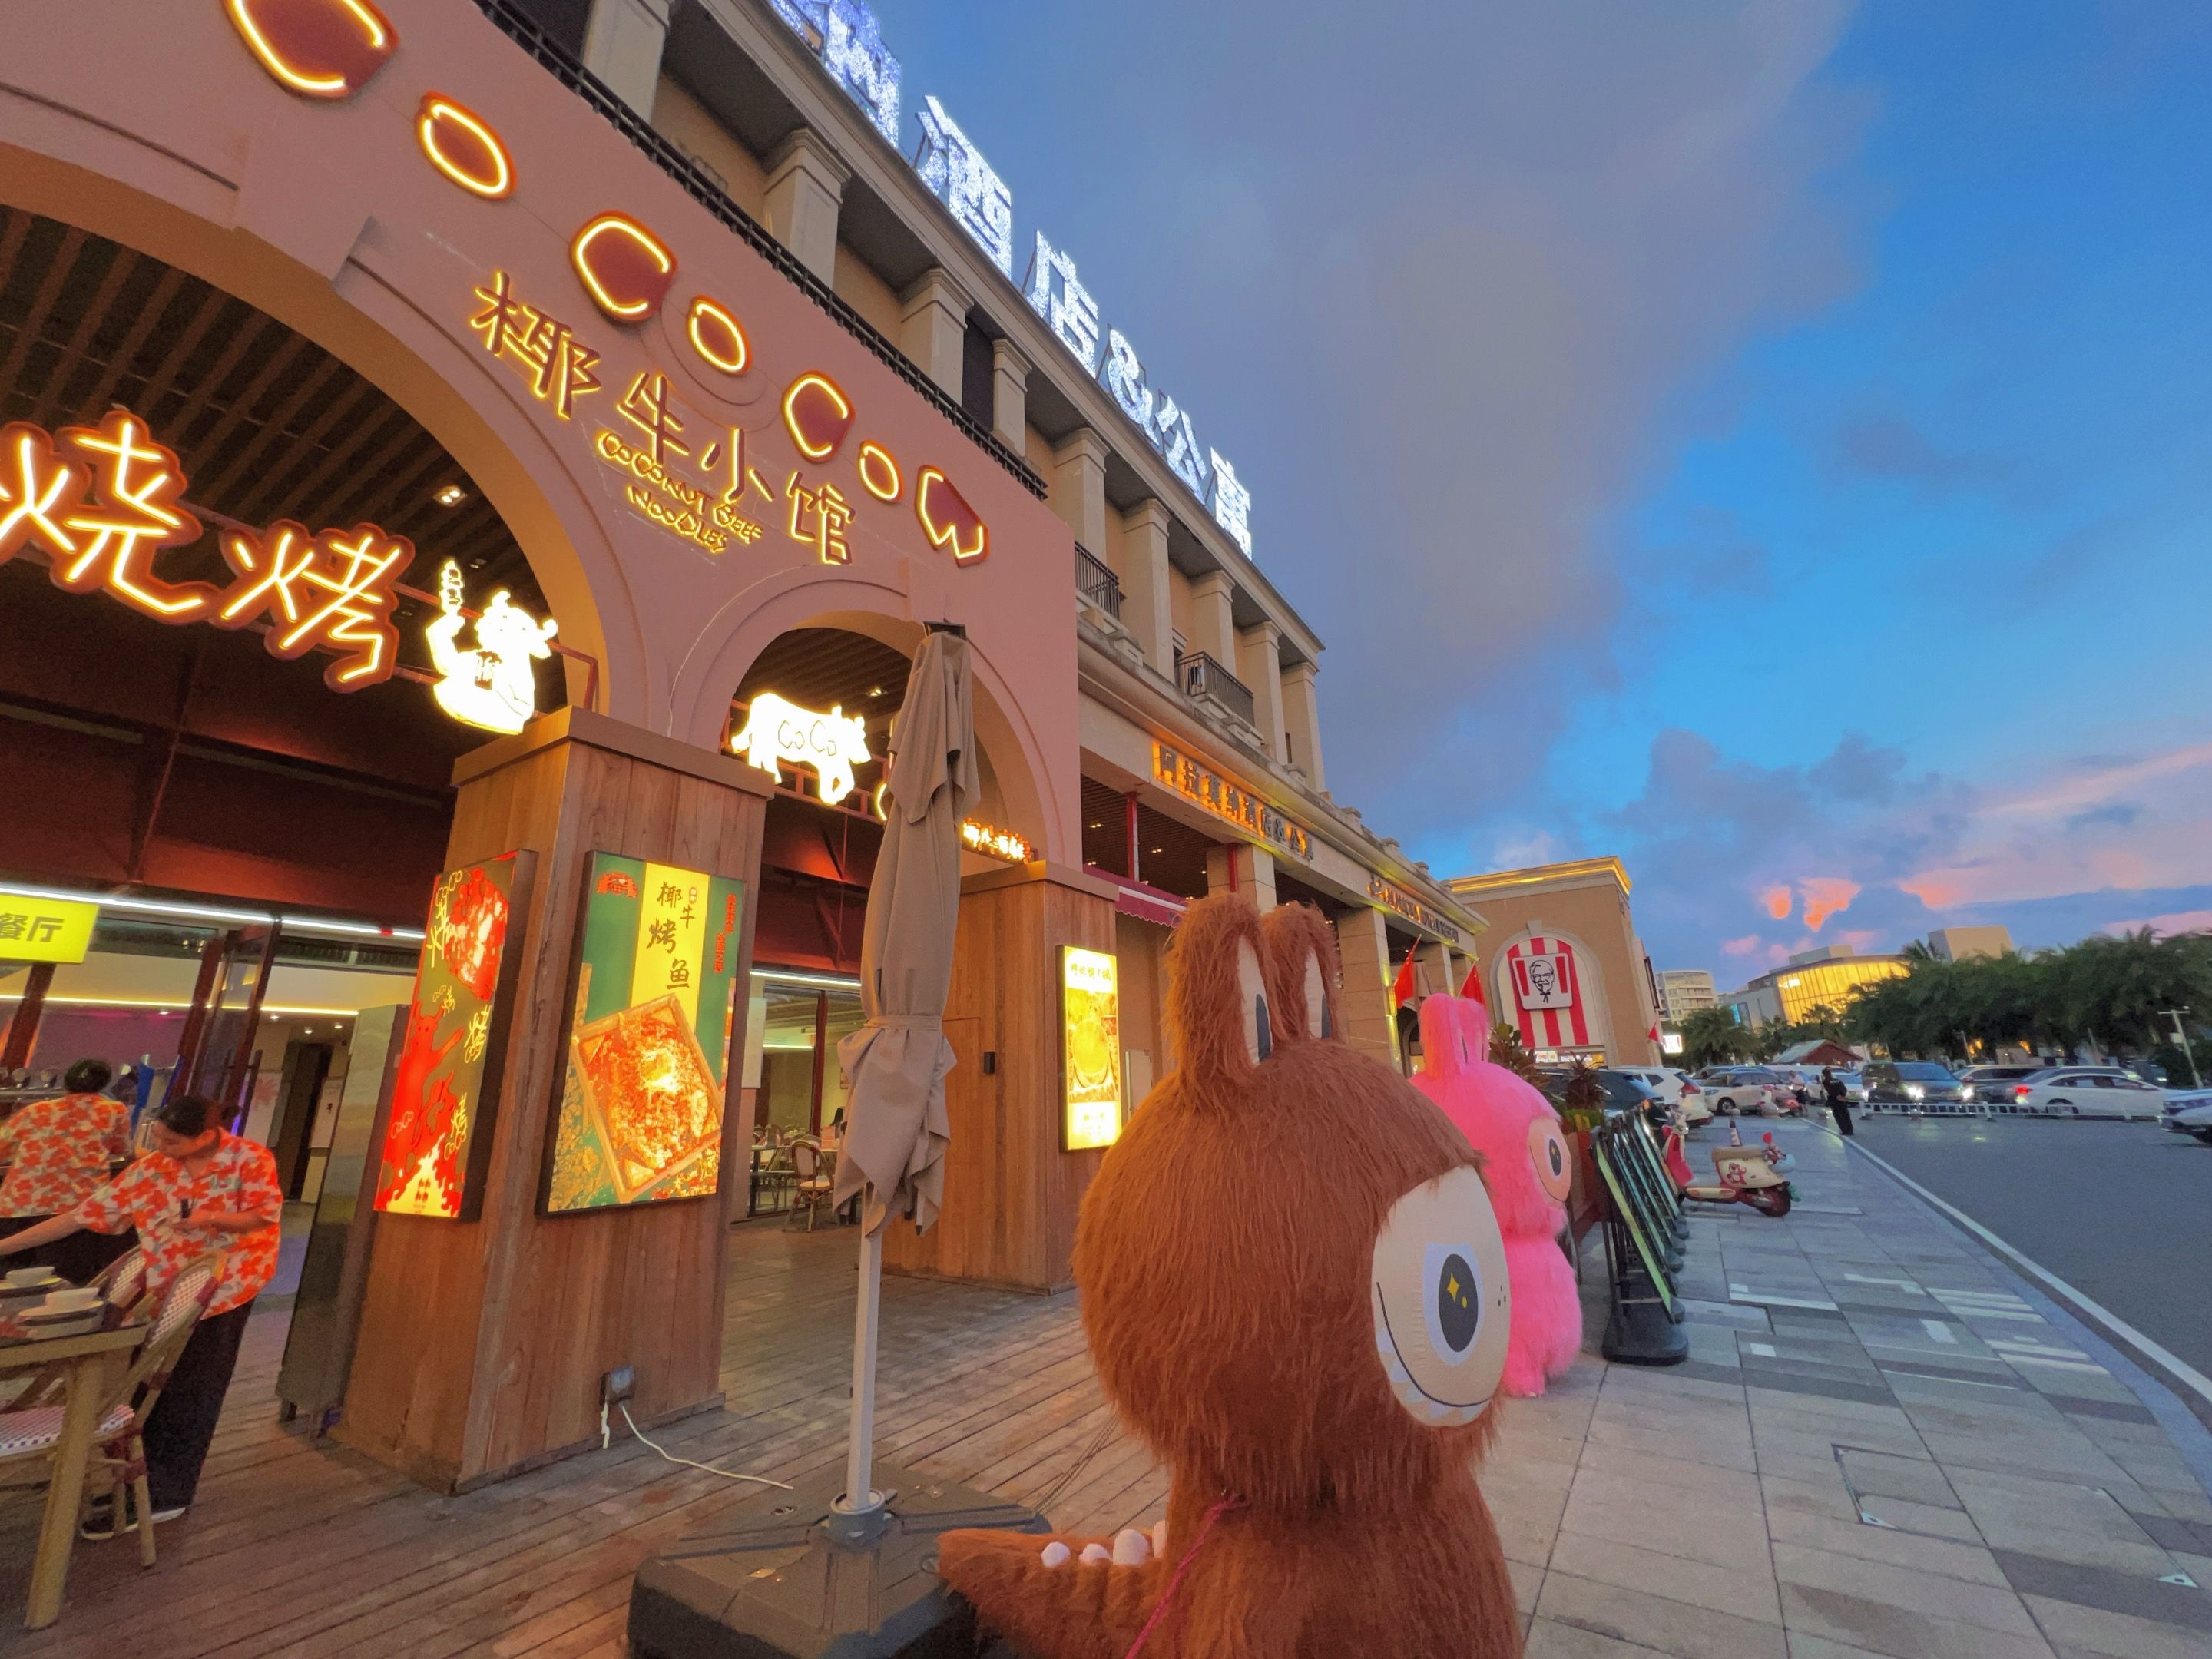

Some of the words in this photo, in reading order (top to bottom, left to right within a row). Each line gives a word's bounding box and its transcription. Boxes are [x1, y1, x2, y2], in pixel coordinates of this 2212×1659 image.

[469, 270, 856, 566] 椰牛小馆
[0, 419, 406, 684] 烧烤
[628, 485, 729, 553] NOODLES
[714, 504, 763, 544] BEEF
[0, 912, 65, 942] 餐厅
